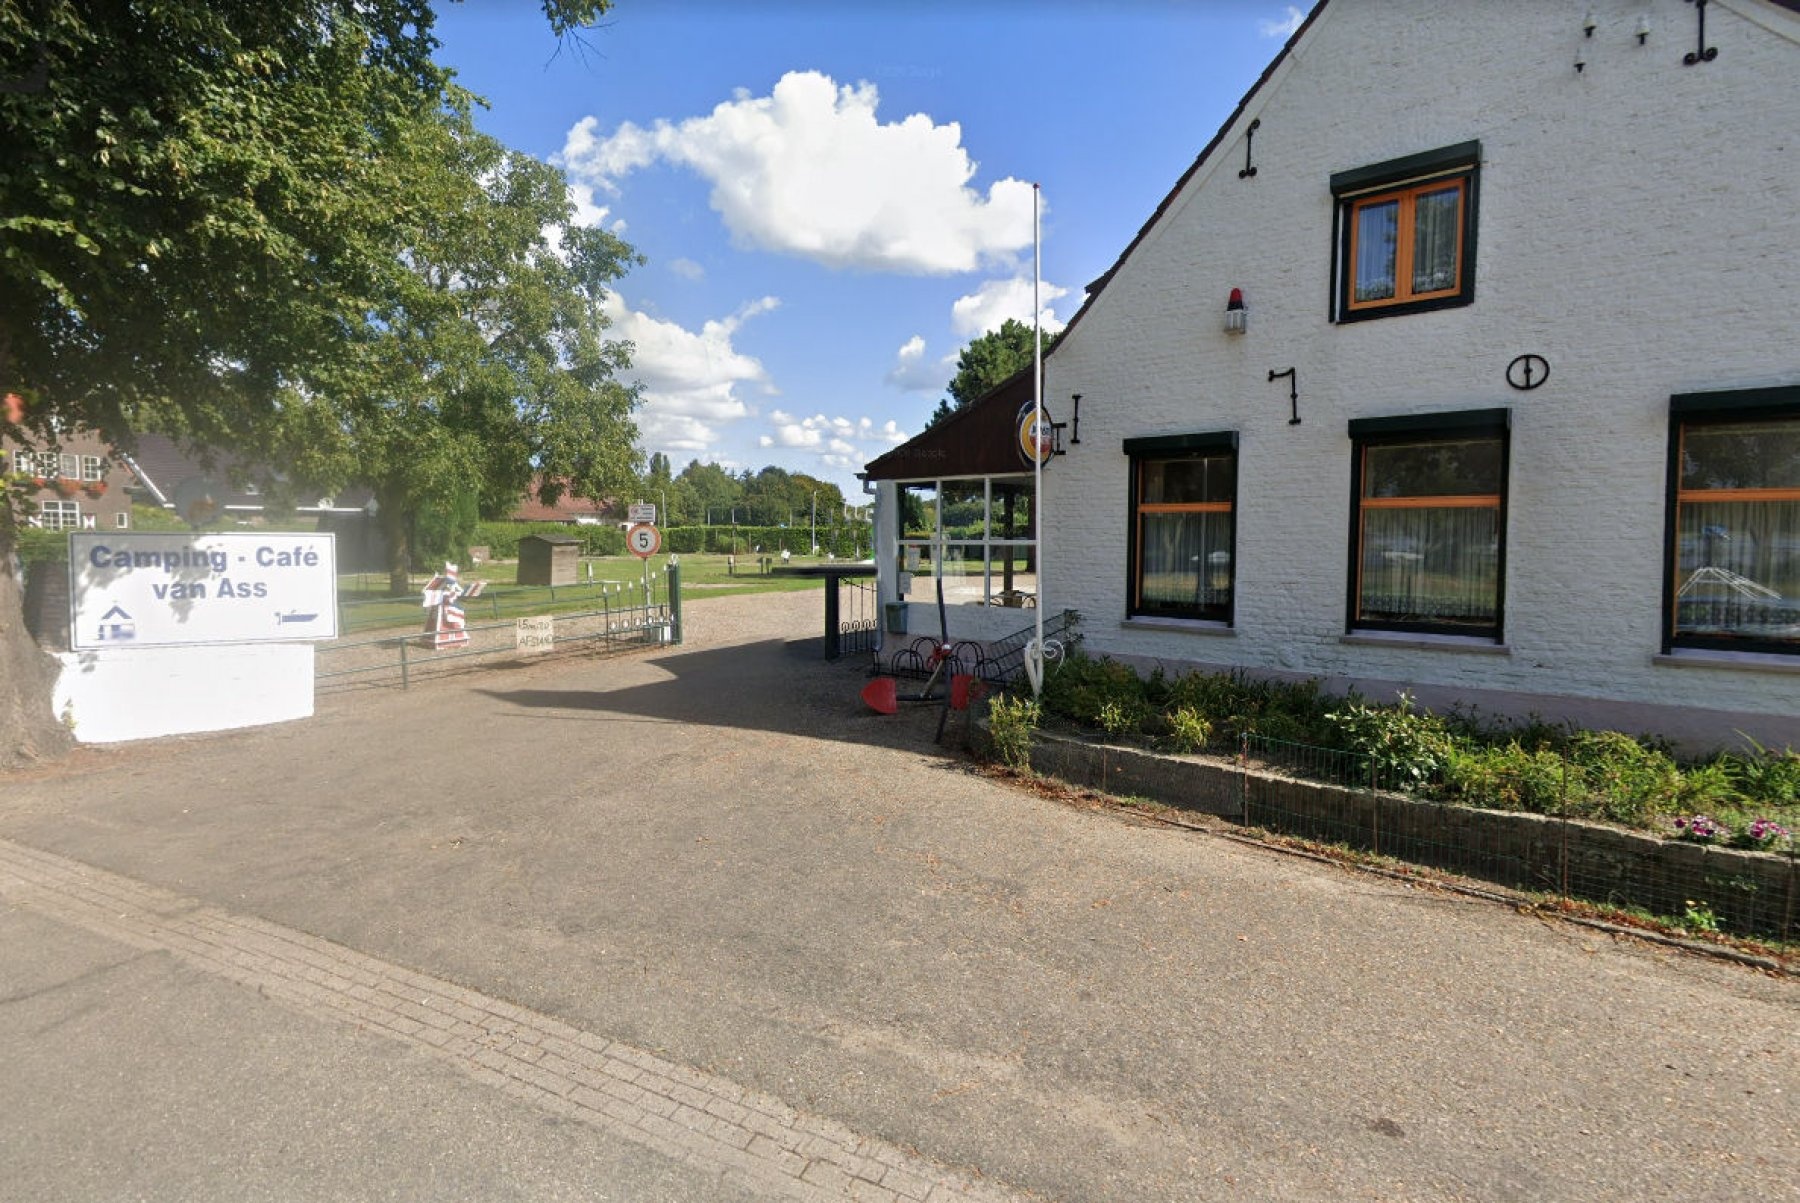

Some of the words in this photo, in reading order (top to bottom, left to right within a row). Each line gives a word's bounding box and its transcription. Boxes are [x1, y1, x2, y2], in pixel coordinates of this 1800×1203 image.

[639, 533, 649, 548] 5
[89, 544, 228, 573] Camping
[255, 544, 319, 568] Café
[152, 581, 207, 600] van
[216, 577, 268, 599] Ass
